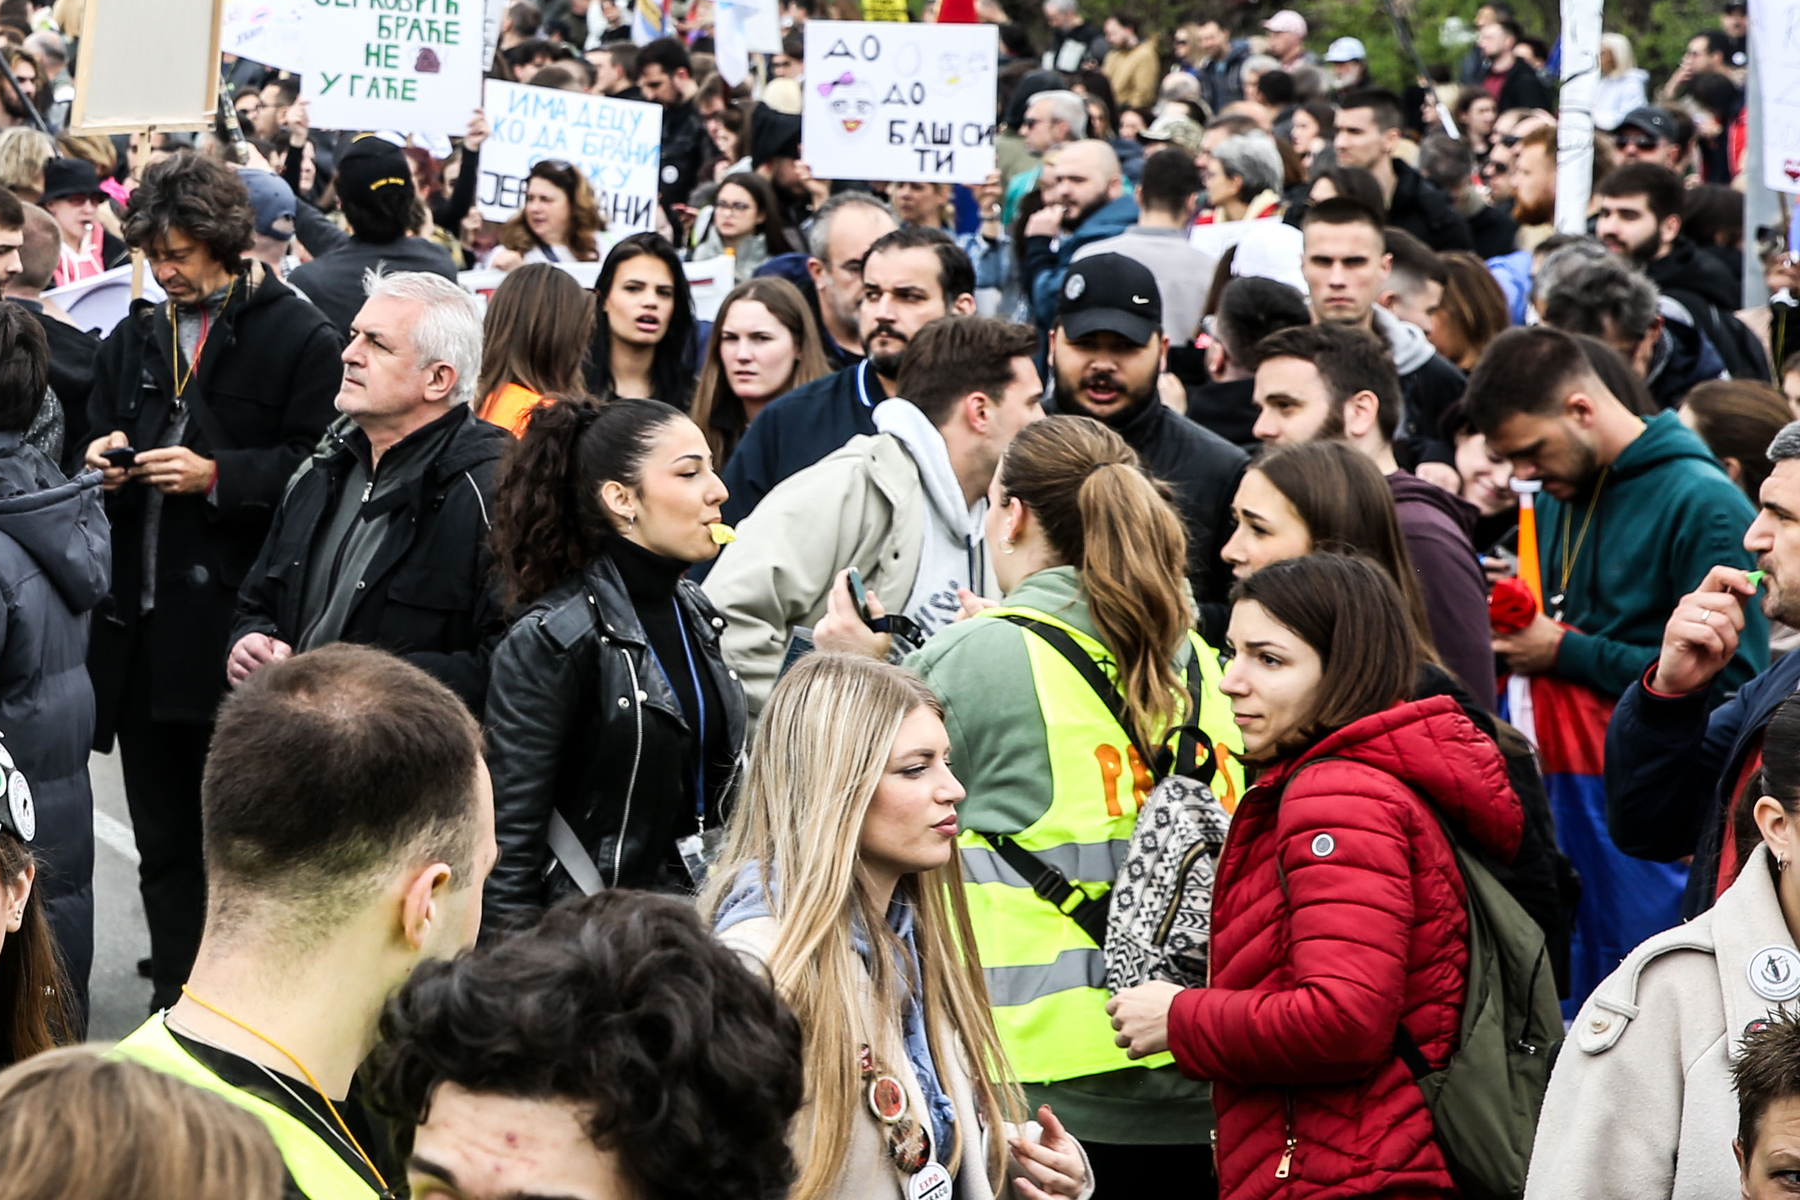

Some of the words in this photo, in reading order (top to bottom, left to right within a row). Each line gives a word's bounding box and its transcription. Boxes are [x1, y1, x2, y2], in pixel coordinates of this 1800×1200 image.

[378, 15, 460, 45] БРАЋЕ
[365, 43, 399, 69] НЕ
[823, 34, 881, 61] ДО
[882, 82, 926, 106] ДО
[508, 89, 568, 121] ИМА
[572, 102, 643, 133] ДЕЦУ
[492, 115, 526, 145] КО
[530, 125, 568, 151] ДА
[582, 132, 661, 167] БРАНИ
[889, 119, 953, 145] БАШ
[914, 148, 955, 173] ТИ
[1094, 741, 1236, 817] PRS
[918, 1173, 940, 1192] EXPO
